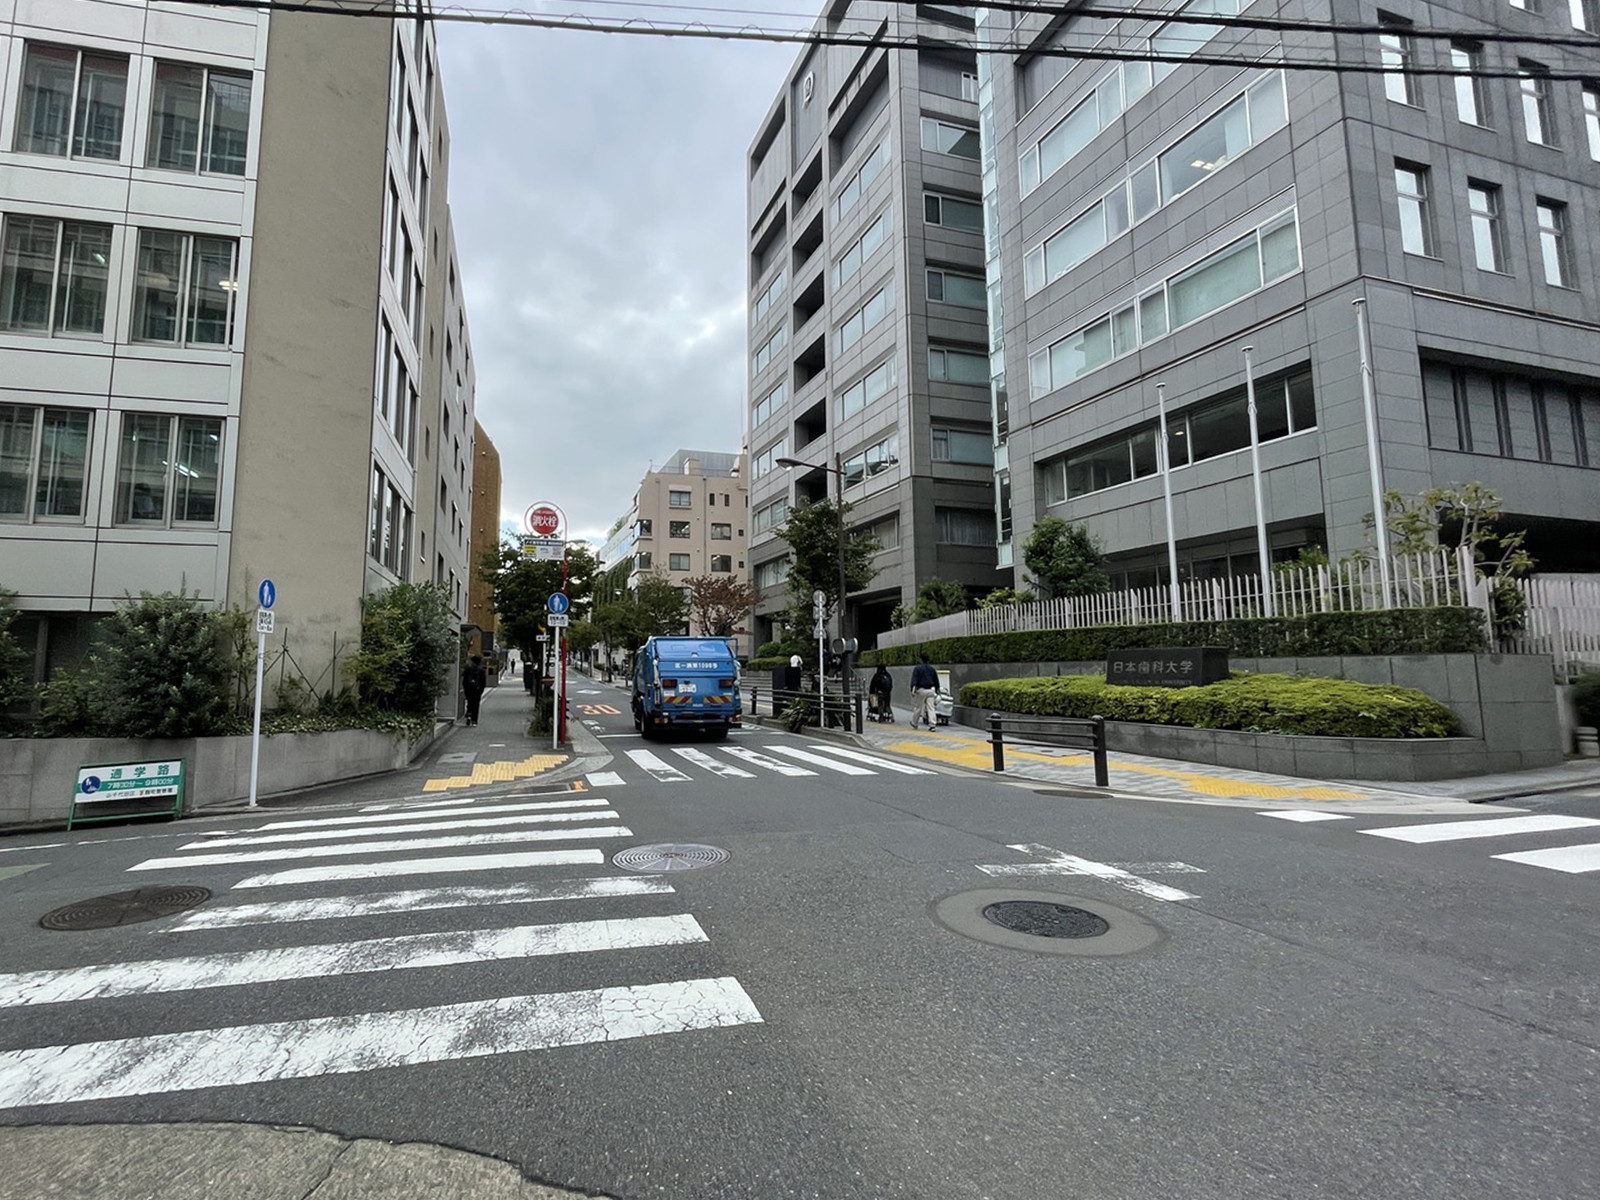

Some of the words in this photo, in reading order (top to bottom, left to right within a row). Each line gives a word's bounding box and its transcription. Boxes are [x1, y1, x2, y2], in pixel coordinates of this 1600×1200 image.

[533, 515, 557, 527] 消火栓
[1113, 661, 1193, 674] 日本歯科大学
[576, 704, 622, 715] 30
[110, 765, 170, 779] 通学路
